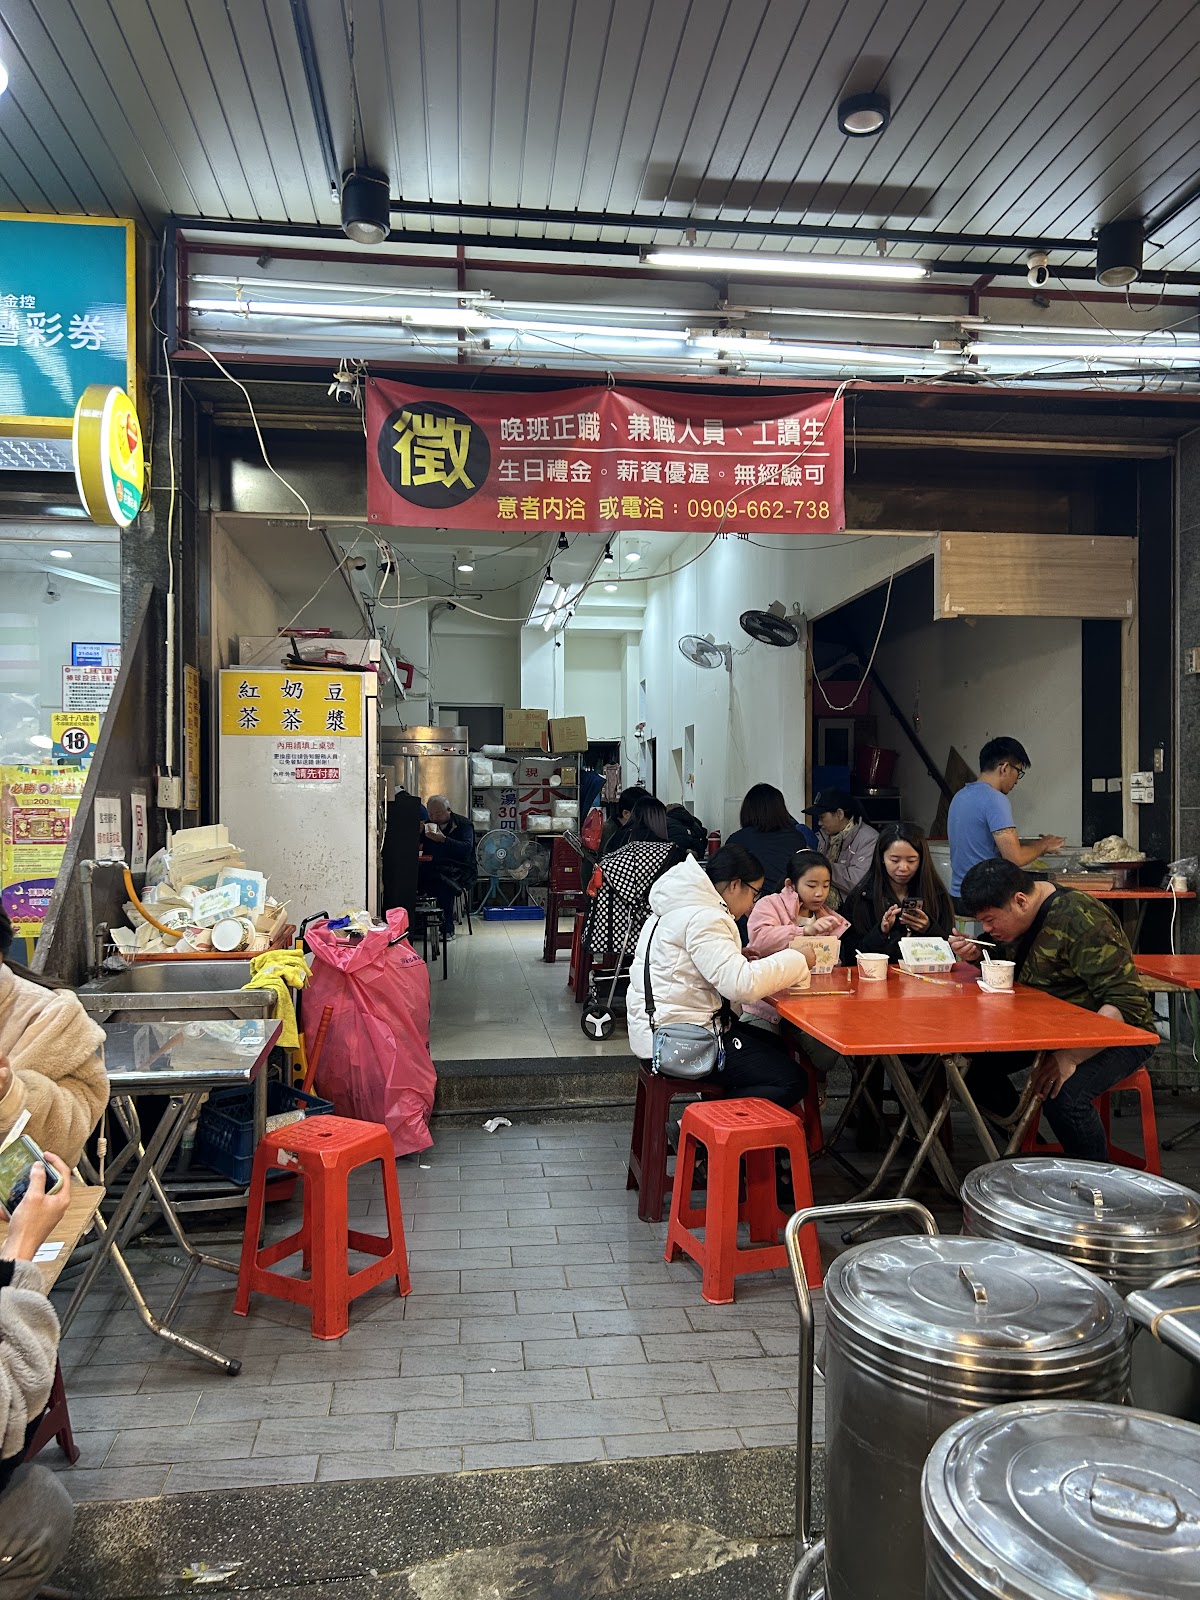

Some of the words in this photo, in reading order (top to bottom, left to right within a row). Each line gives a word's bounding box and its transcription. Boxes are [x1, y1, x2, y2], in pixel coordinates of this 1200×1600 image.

[500, 413, 825, 447] 晚班正職、兼職人員、工讀生
[393, 411, 475, 489] 徵
[498, 458, 825, 487] 生日禮金。薪資優渥。無經驗可
[238, 681, 260, 729] 紅茶
[281, 680, 303, 731] 奶茶
[324, 684, 347, 731] 豆漿
[65, 732, 86, 750] 18
[296, 768, 339, 779] 請先付款
[498, 807, 517, 818] 30
